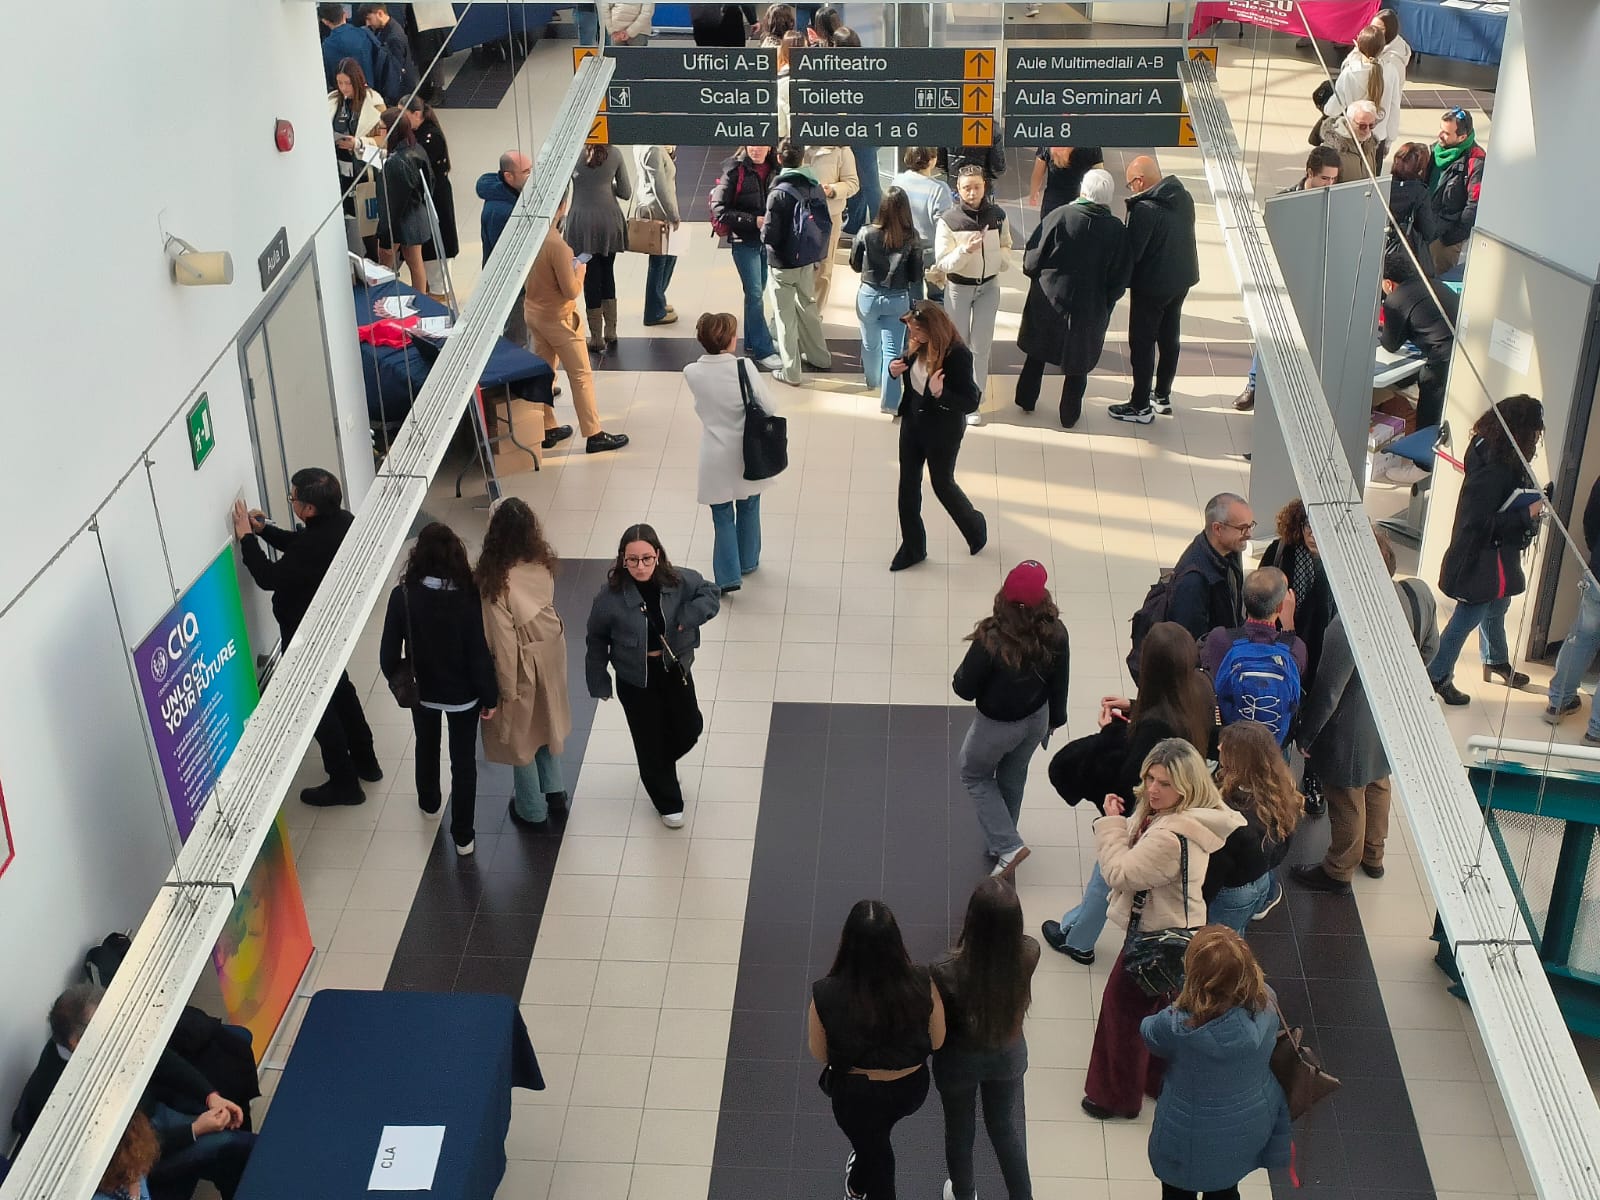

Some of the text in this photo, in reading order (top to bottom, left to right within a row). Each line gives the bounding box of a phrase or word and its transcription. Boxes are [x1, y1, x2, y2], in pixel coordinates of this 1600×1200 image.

[682, 53, 770, 71] Uffici A-B
[798, 53, 888, 71] Anfiteatro
[1016, 54, 1165, 70] Aule Multimediali A-B
[700, 87, 770, 105] Scala D
[797, 87, 864, 105] Toilette
[1014, 87, 1162, 106] Aula Seminari A
[714, 121, 771, 138] Aula 7
[799, 121, 918, 138] Aule da 1 a 6
[1013, 121, 1072, 139] Aula 8
[161, 652, 208, 721] UNLOCK
[165, 688, 196, 736] YOUR
[195, 638, 237, 698] FUTURE
[380, 1146, 397, 1169] CLA
